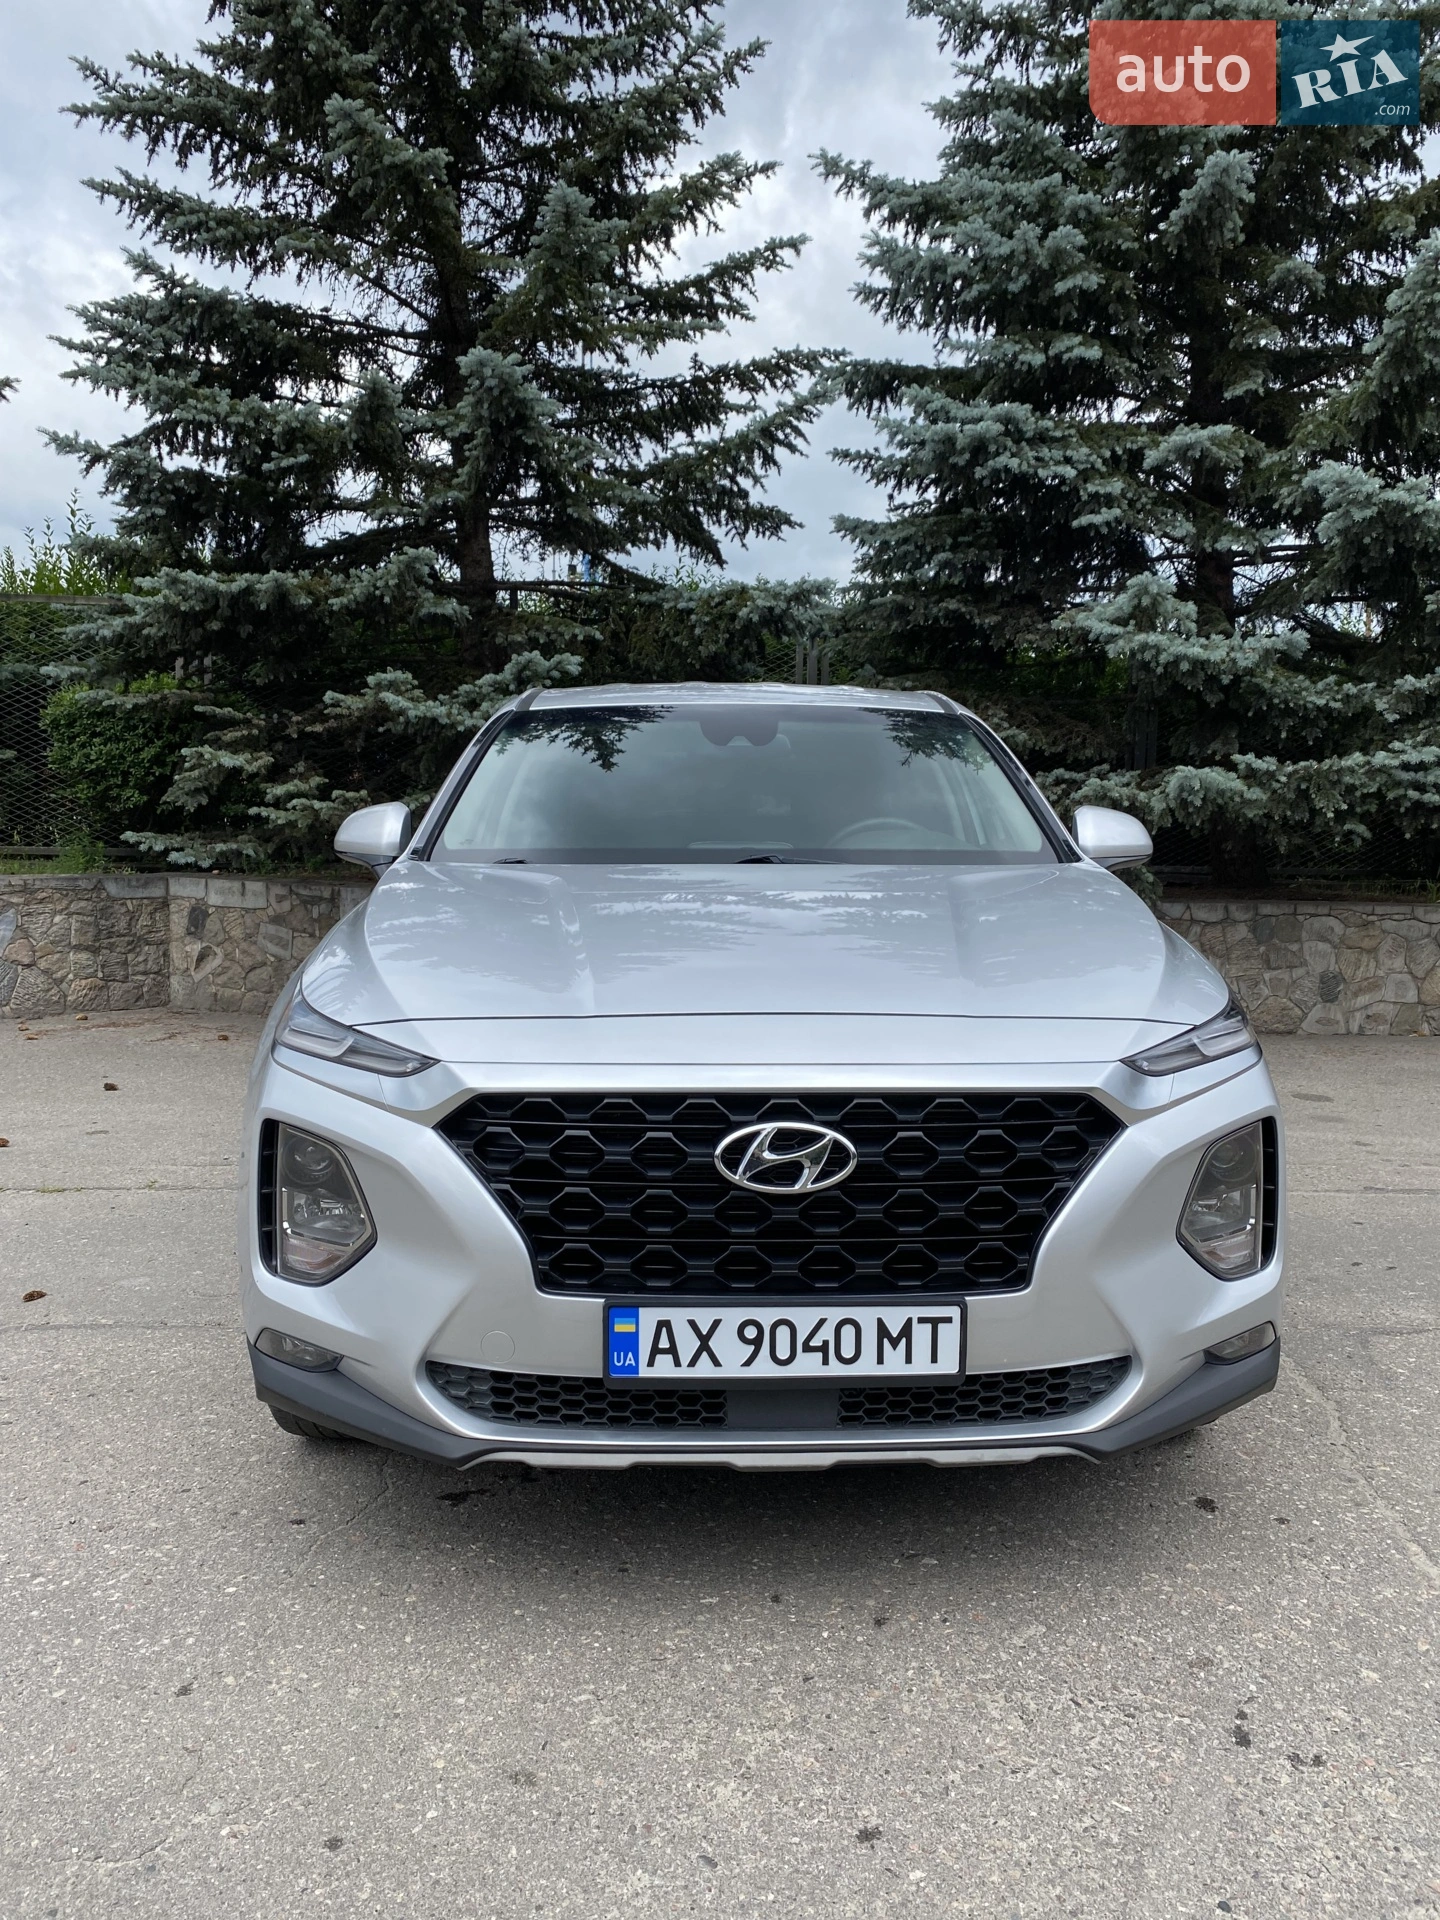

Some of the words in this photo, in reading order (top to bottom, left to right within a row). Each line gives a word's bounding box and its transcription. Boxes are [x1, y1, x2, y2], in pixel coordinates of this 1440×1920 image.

[613, 1351, 636, 1367] UA
[646, 1318, 723, 1368] AX
[736, 1316, 862, 1367] 9040
[876, 1316, 953, 1365] MT
